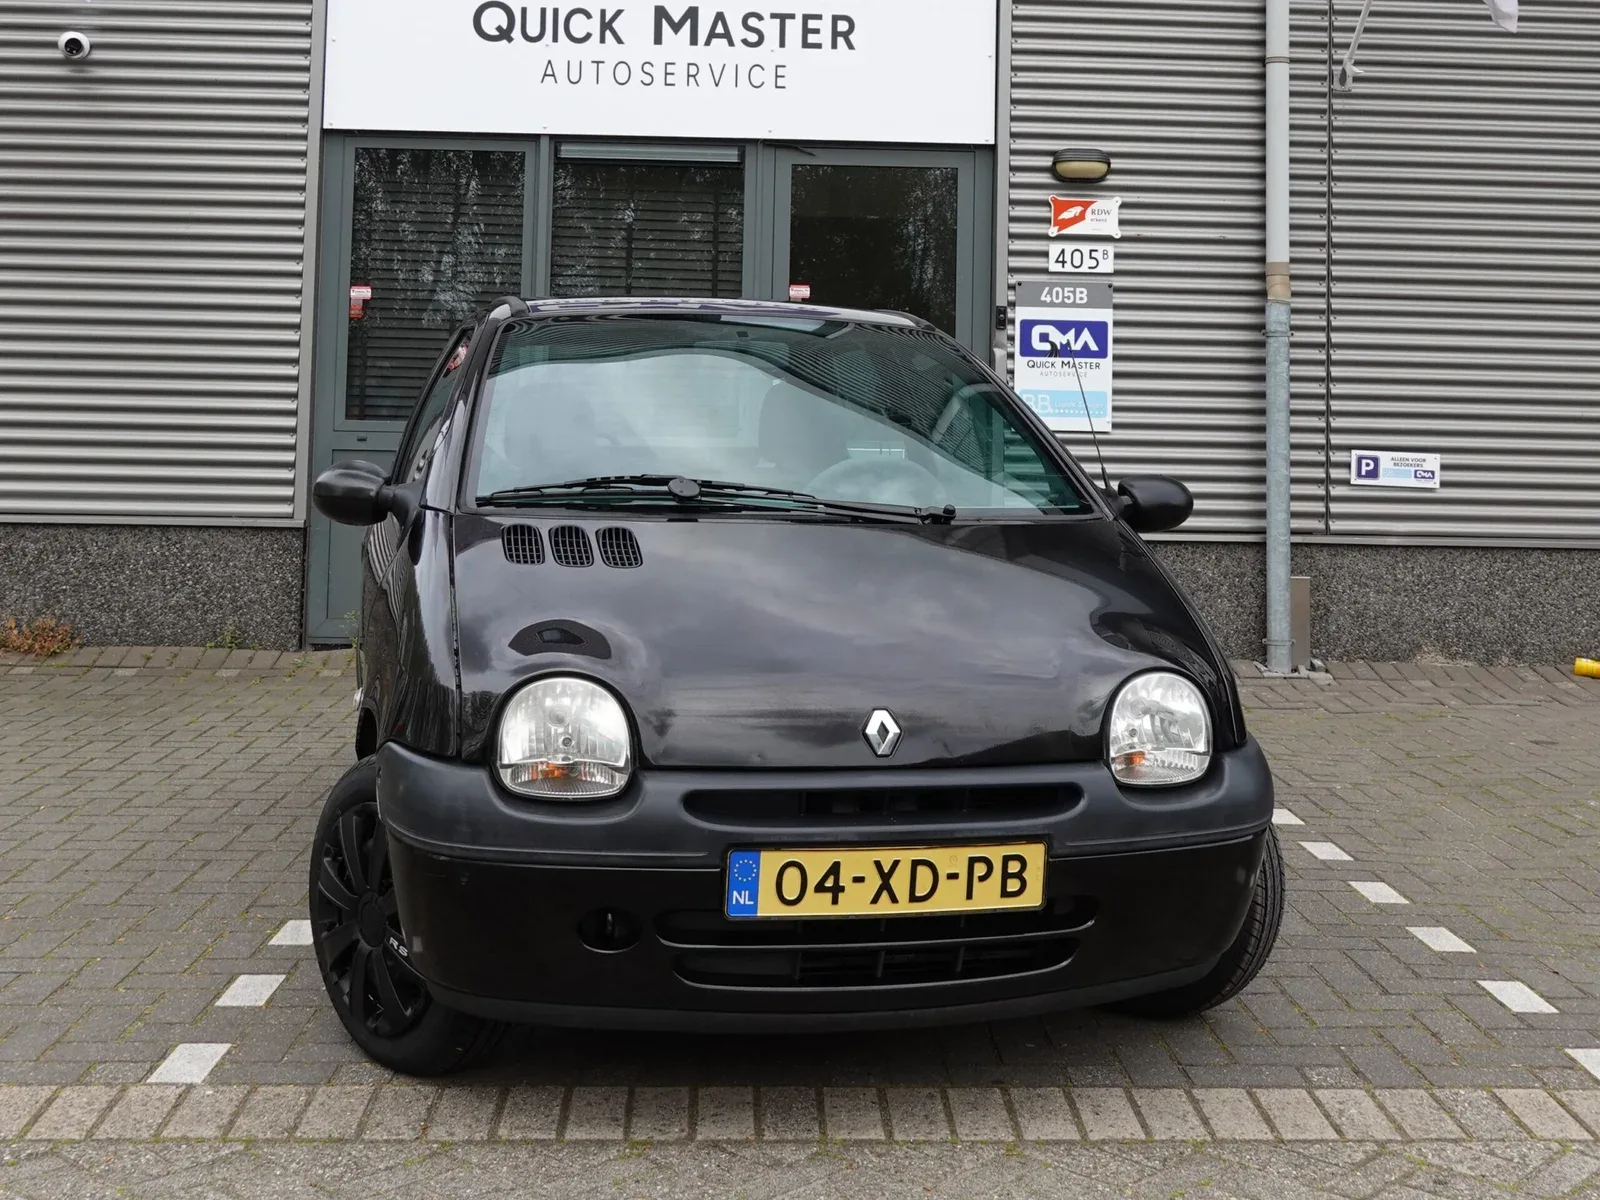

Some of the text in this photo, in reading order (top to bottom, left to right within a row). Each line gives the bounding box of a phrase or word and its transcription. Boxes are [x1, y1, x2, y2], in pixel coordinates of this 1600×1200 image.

[473, 0, 856, 50] QUICK MASTER
[540, 59, 787, 89] AUTOSERVICE
[1091, 208, 1112, 216] RDW
[1040, 286, 1088, 304] 405B
[1026, 359, 1101, 370] QUICK MASTER
[1361, 459, 1375, 476] P
[775, 853, 1028, 907] 04-XD-PB
[732, 890, 754, 905] NL
[389, 936, 408, 957] RS
